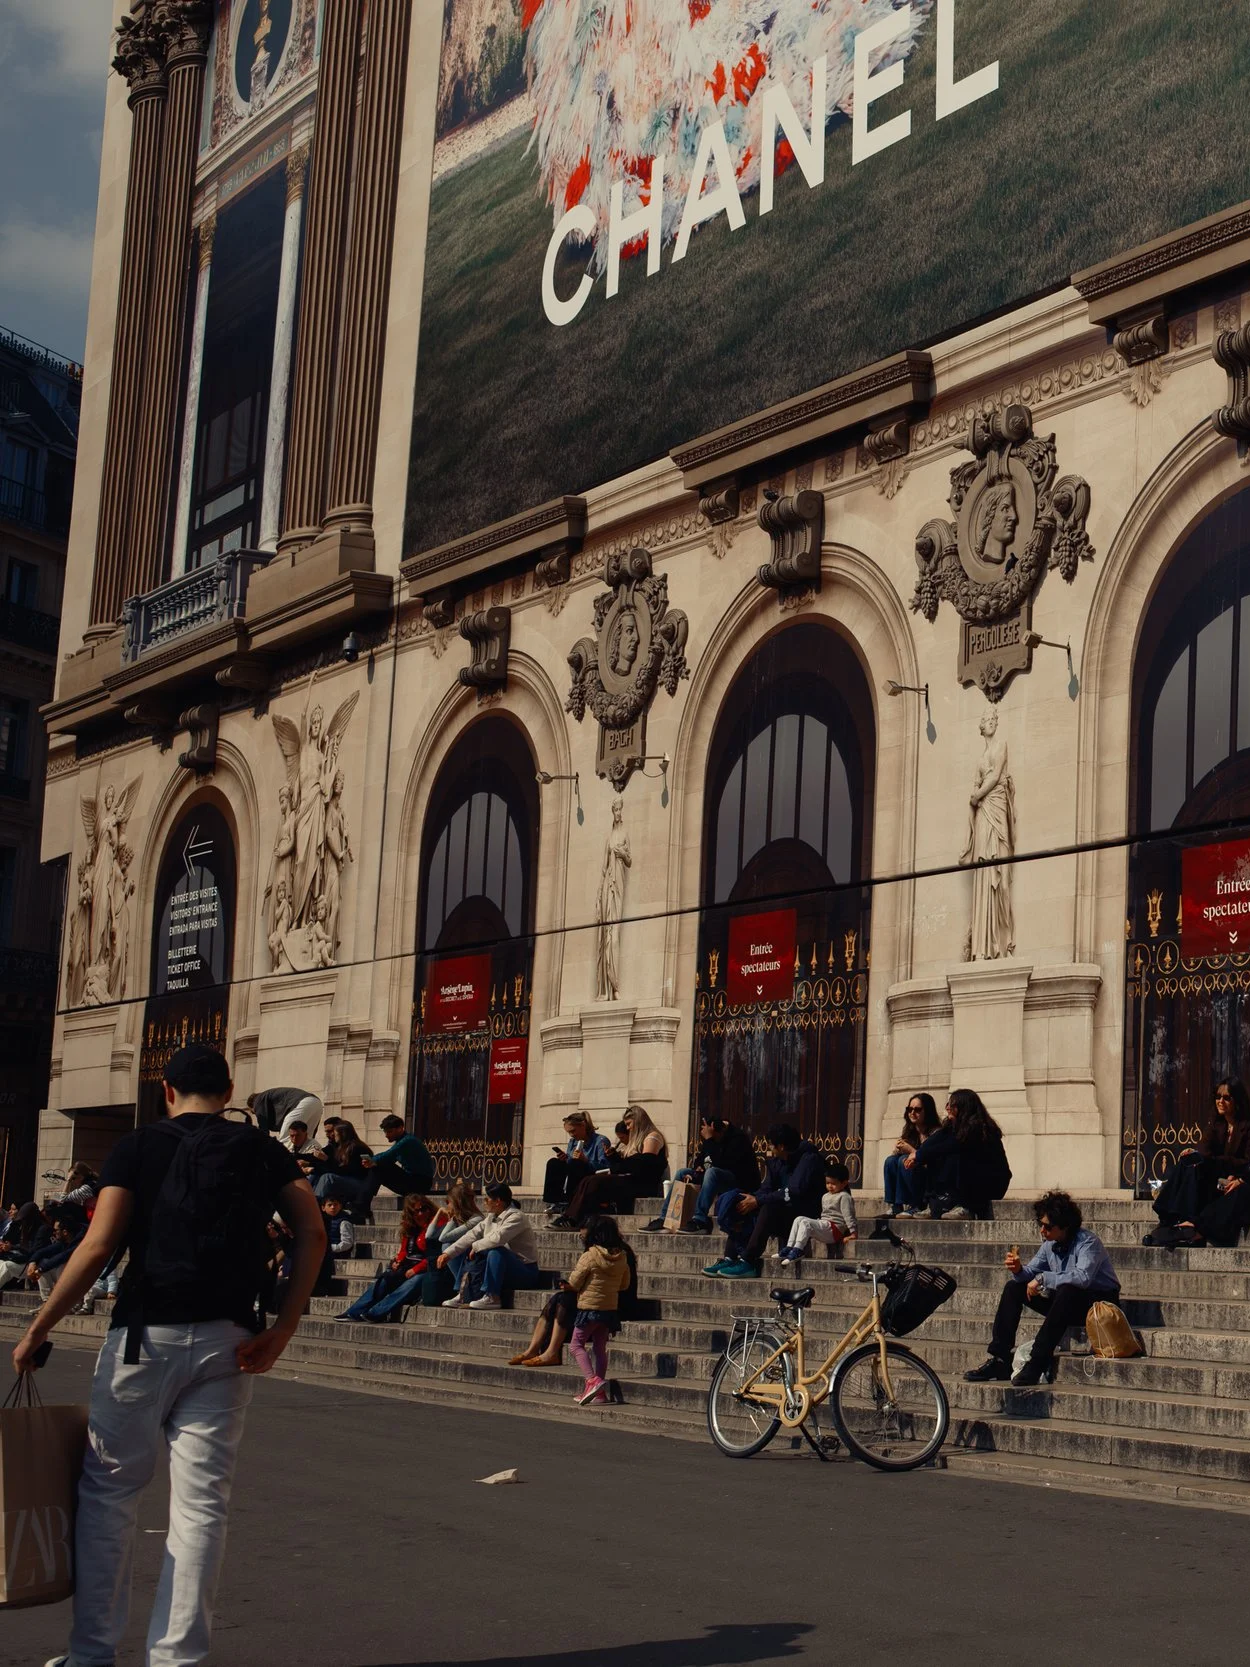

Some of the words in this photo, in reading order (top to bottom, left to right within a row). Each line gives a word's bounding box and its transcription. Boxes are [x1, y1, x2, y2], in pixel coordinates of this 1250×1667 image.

[541, 0, 1000, 327] CHANEL
[608, 728, 634, 751] BACH
[171, 891, 189, 906] ENTRÉE
[189, 890, 199, 901] DES
[200, 886, 218, 899] VISITES
[193, 901, 218, 916] ENTRANCE
[169, 923, 189, 937] ENTRADA
[189, 920, 201, 932] PARA
[201, 917, 218, 929] VISITAS
[168, 944, 197, 960] BILLETTERIE
[750, 942, 773, 956] Entrée
[167, 963, 184, 975] TICKET
[184, 959, 201, 972] OFFICE
[741, 960, 781, 977] spectateurs
[167, 977, 190, 990] TAQUILLA
[4, 1505, 73, 1590] ZAR
